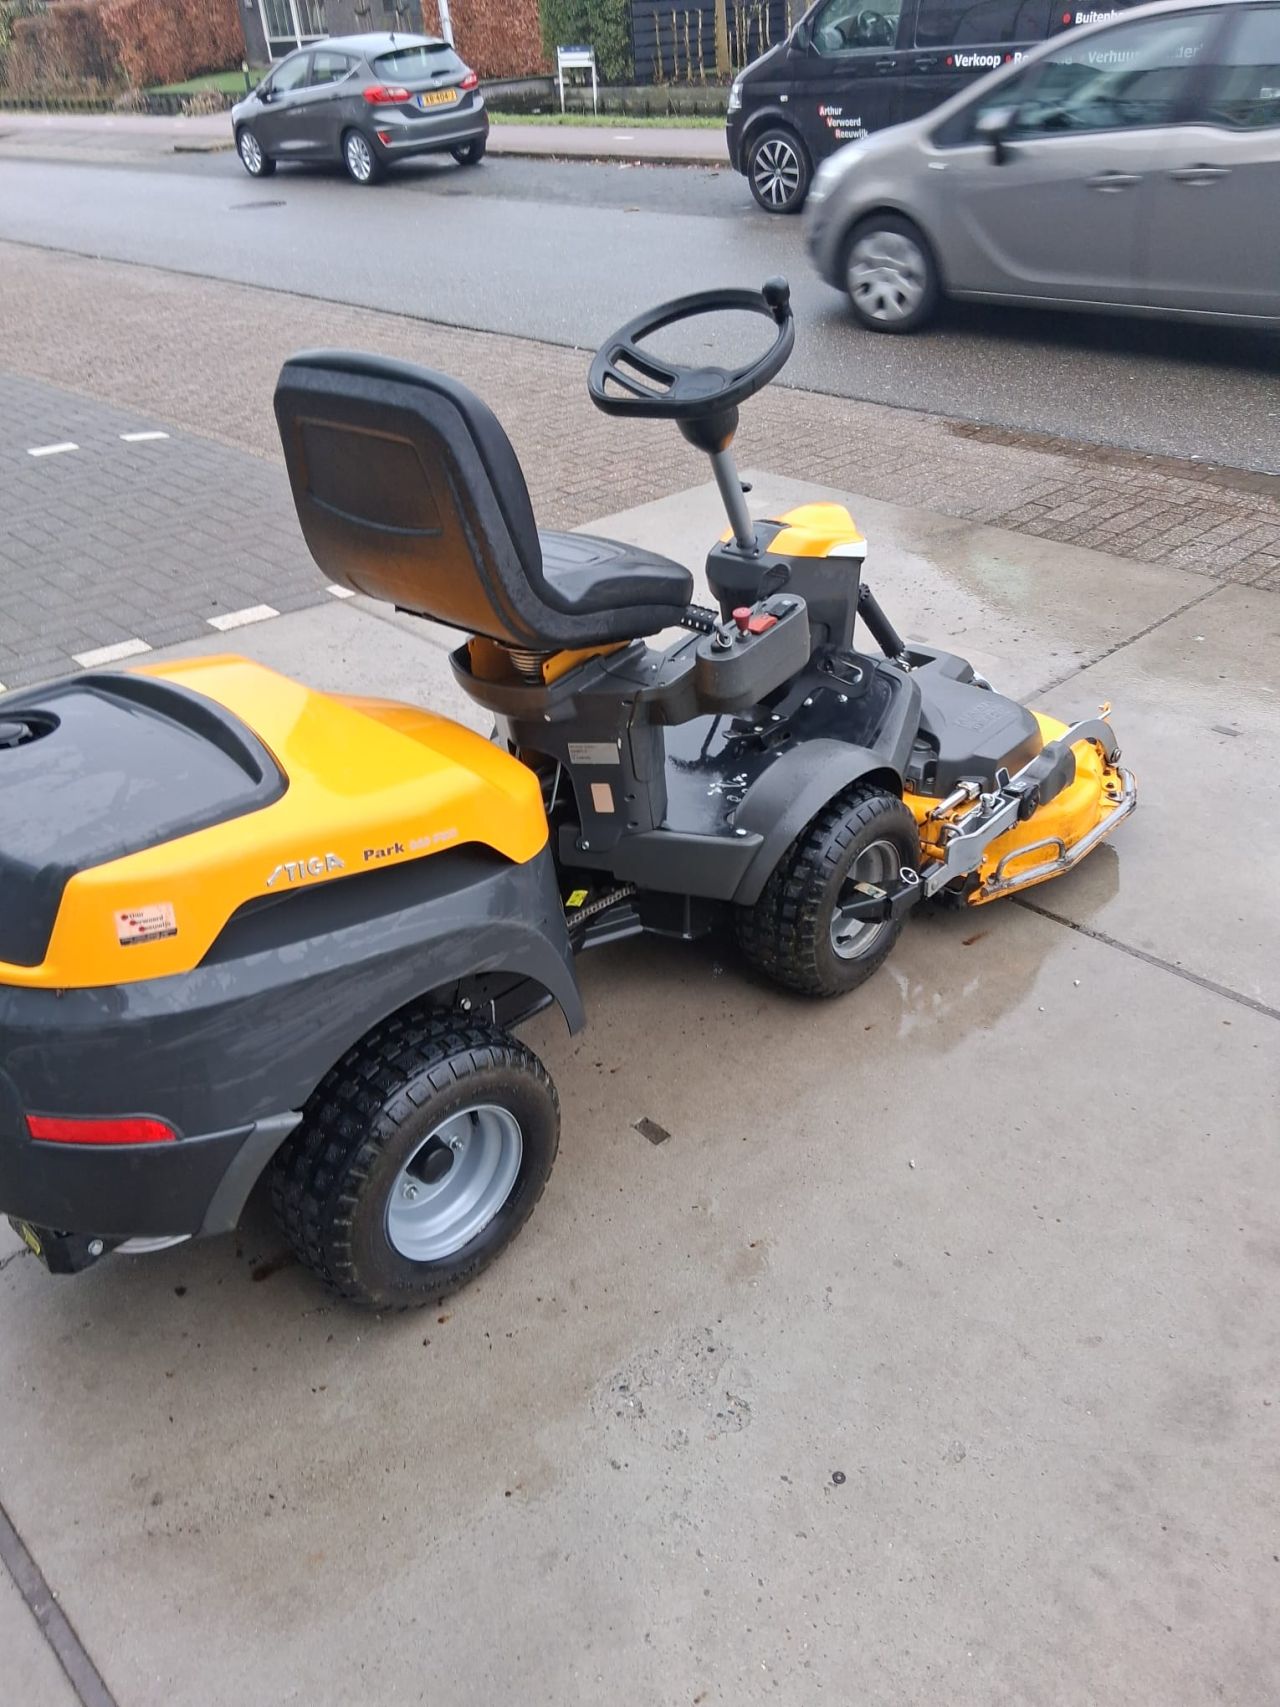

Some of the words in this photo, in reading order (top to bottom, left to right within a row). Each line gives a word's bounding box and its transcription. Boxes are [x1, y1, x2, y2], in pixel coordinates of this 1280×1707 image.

[954, 52, 1001, 68] Verkoop
[819, 105, 843, 116] Arthur
[827, 116, 862, 128] Verwoerd
[835, 128, 869, 140] Reeuwijk
[363, 842, 405, 861] Park
[266, 852, 345, 887] STIGA
